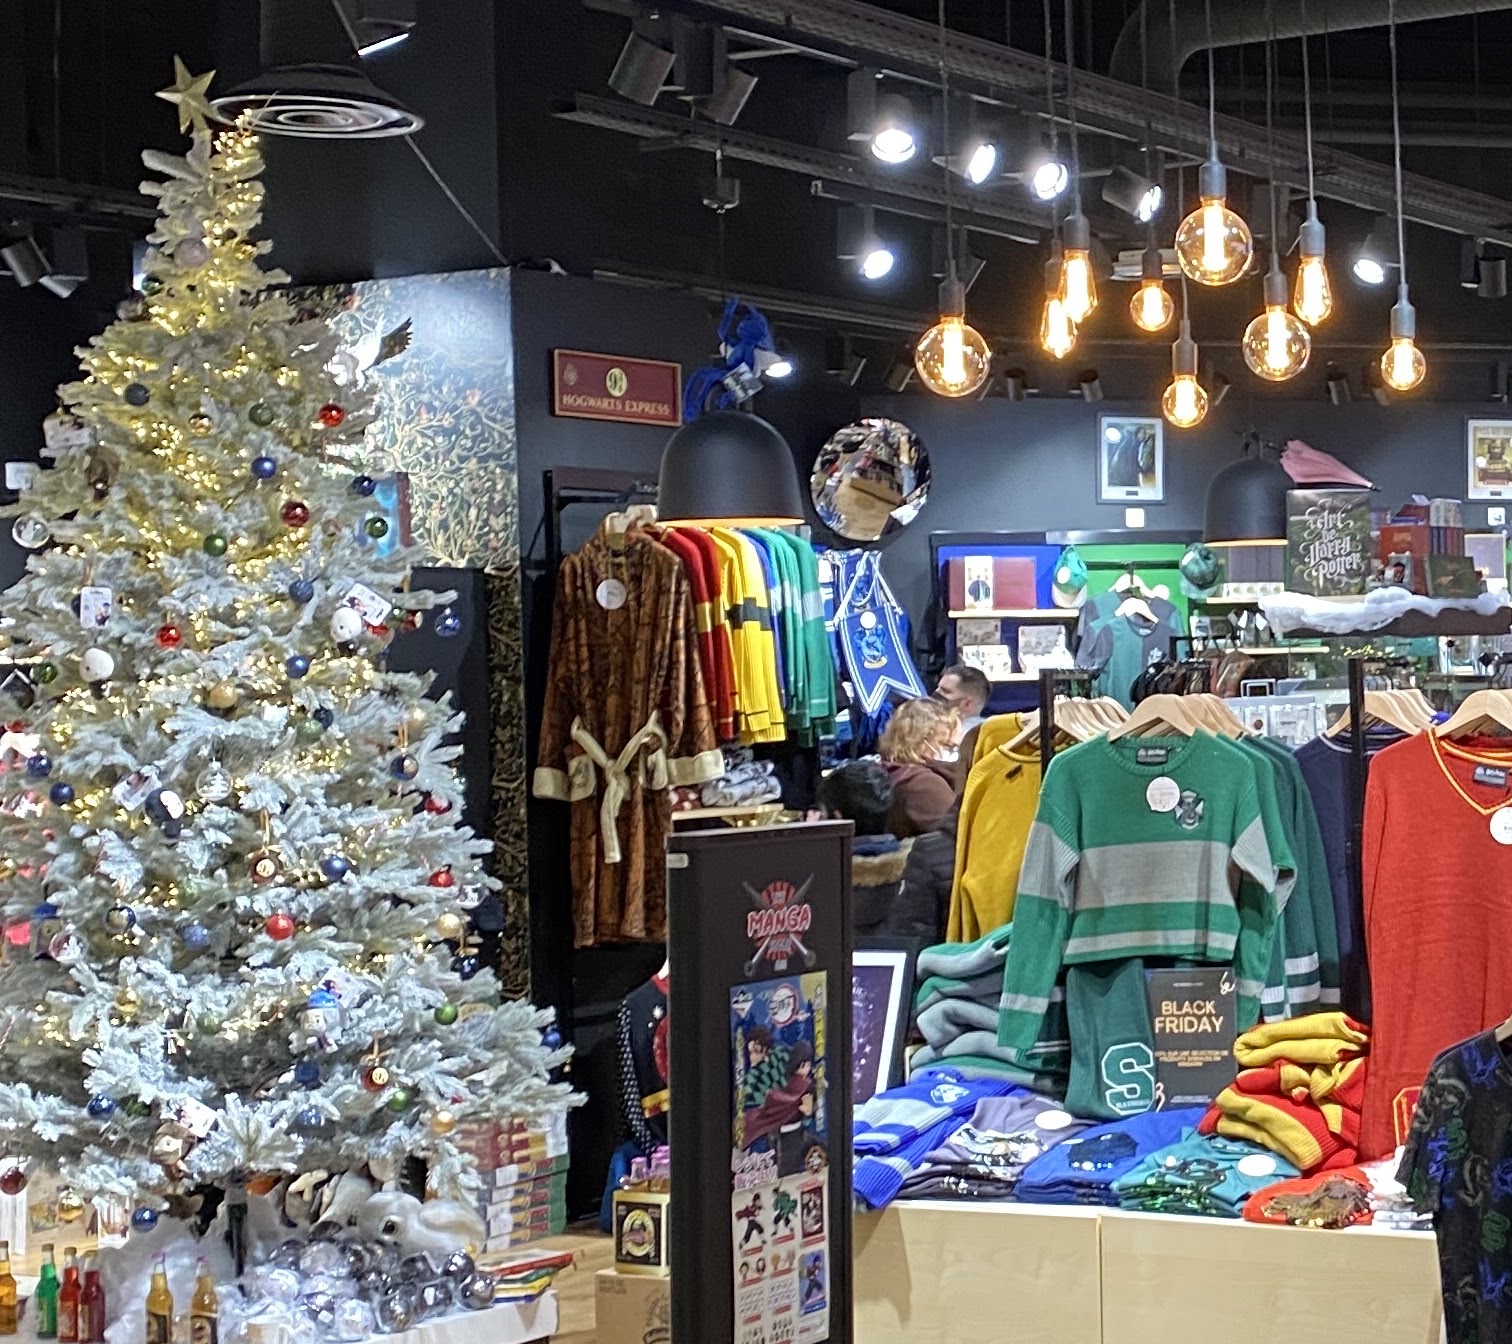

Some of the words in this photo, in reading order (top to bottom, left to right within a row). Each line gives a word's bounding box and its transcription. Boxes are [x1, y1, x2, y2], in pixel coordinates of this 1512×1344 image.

[562, 393, 622, 411] HOGWARTS
[624, 399, 670, 416] EXPRESS
[747, 903, 812, 938] MANGA
[1161, 999, 1217, 1016] BLACK
[1154, 1015, 1224, 1034] FRIDAY
